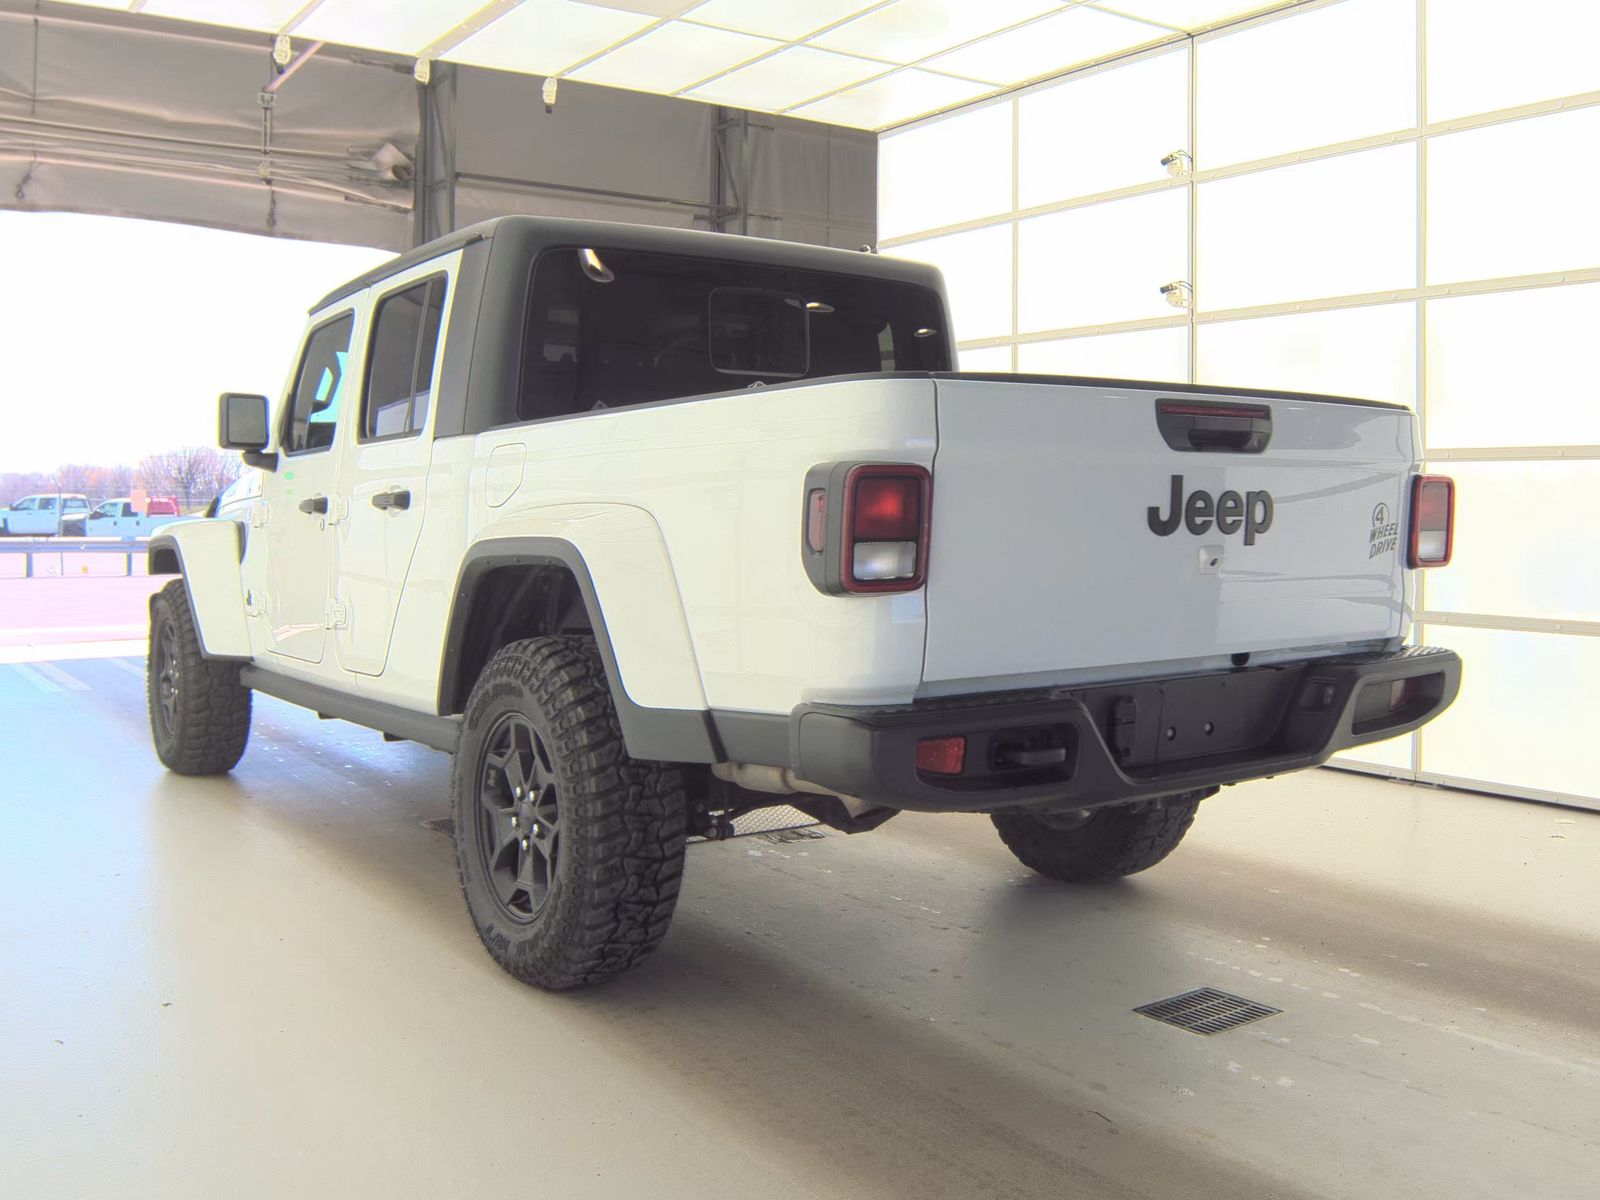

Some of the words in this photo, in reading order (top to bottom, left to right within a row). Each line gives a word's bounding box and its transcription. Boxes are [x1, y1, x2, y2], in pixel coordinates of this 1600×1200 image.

[1147, 474, 1274, 546] Jeep
[1374, 505, 1387, 526] 4
[1369, 522, 1399, 544] WHEEL
[1368, 537, 1397, 560] DRIVE
